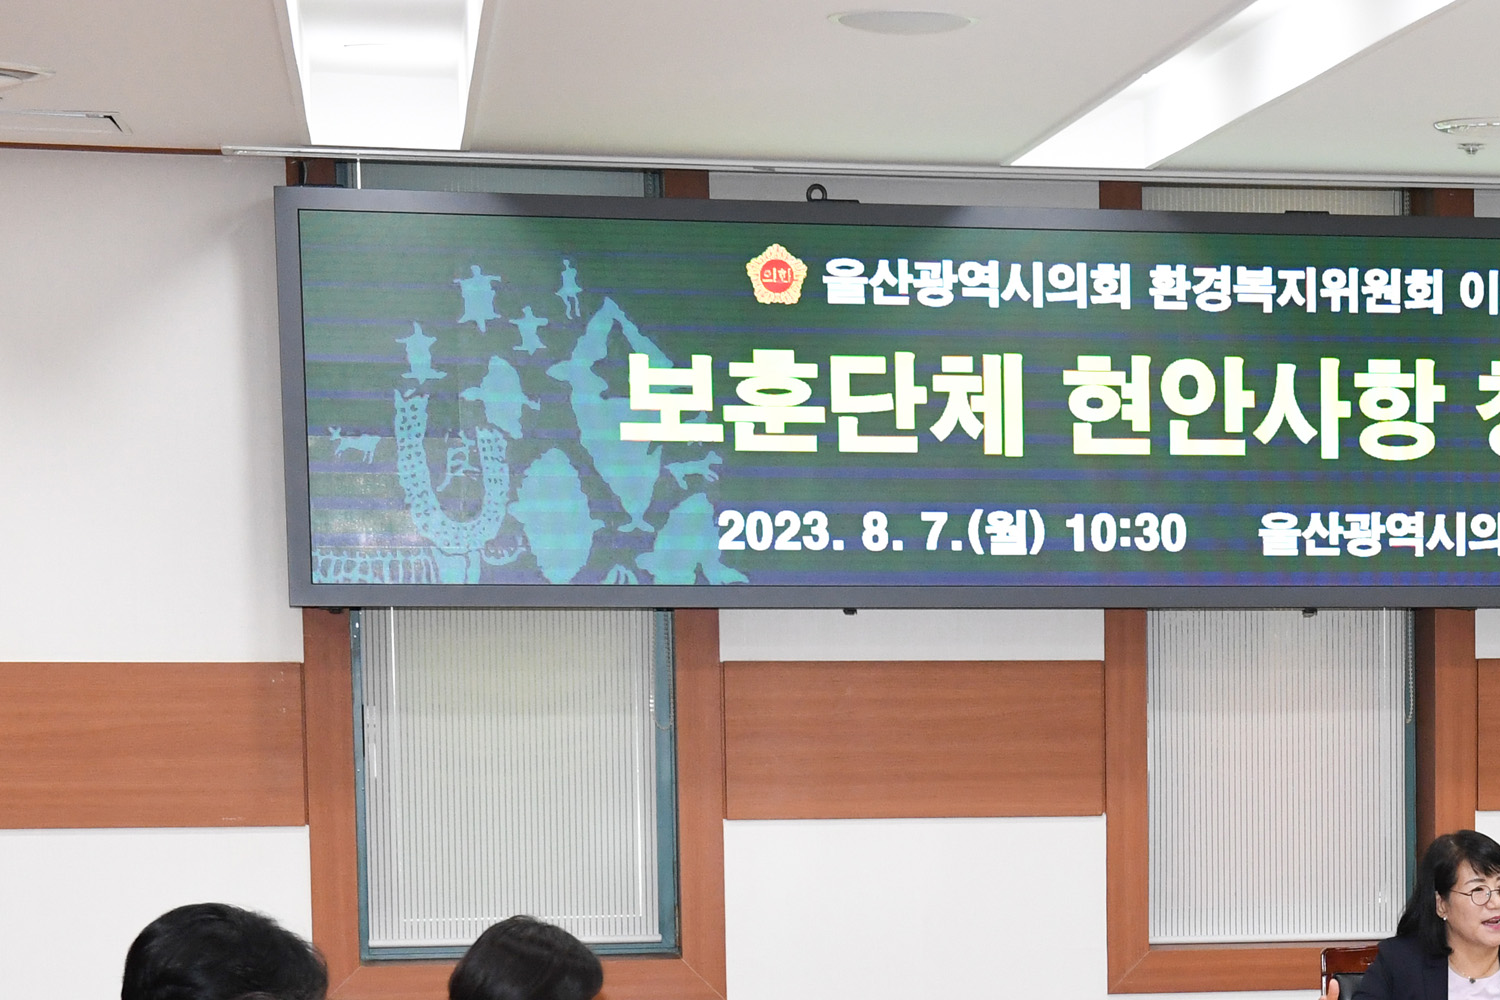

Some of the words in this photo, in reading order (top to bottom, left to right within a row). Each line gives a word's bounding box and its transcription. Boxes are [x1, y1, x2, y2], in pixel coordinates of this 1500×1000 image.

[823, 258, 1130, 310] 울산광역시의회
[1149, 264, 1443, 315] 환경복지위원회
[619, 349, 1024, 457] 보훈단체
[1062, 354, 1446, 461] 현안사항
[718, 509, 845, 551] 2023.
[861, 510, 904, 552] 8.
[920, 509, 1045, 556] 7.(월)
[1065, 512, 1187, 553] 10:30
